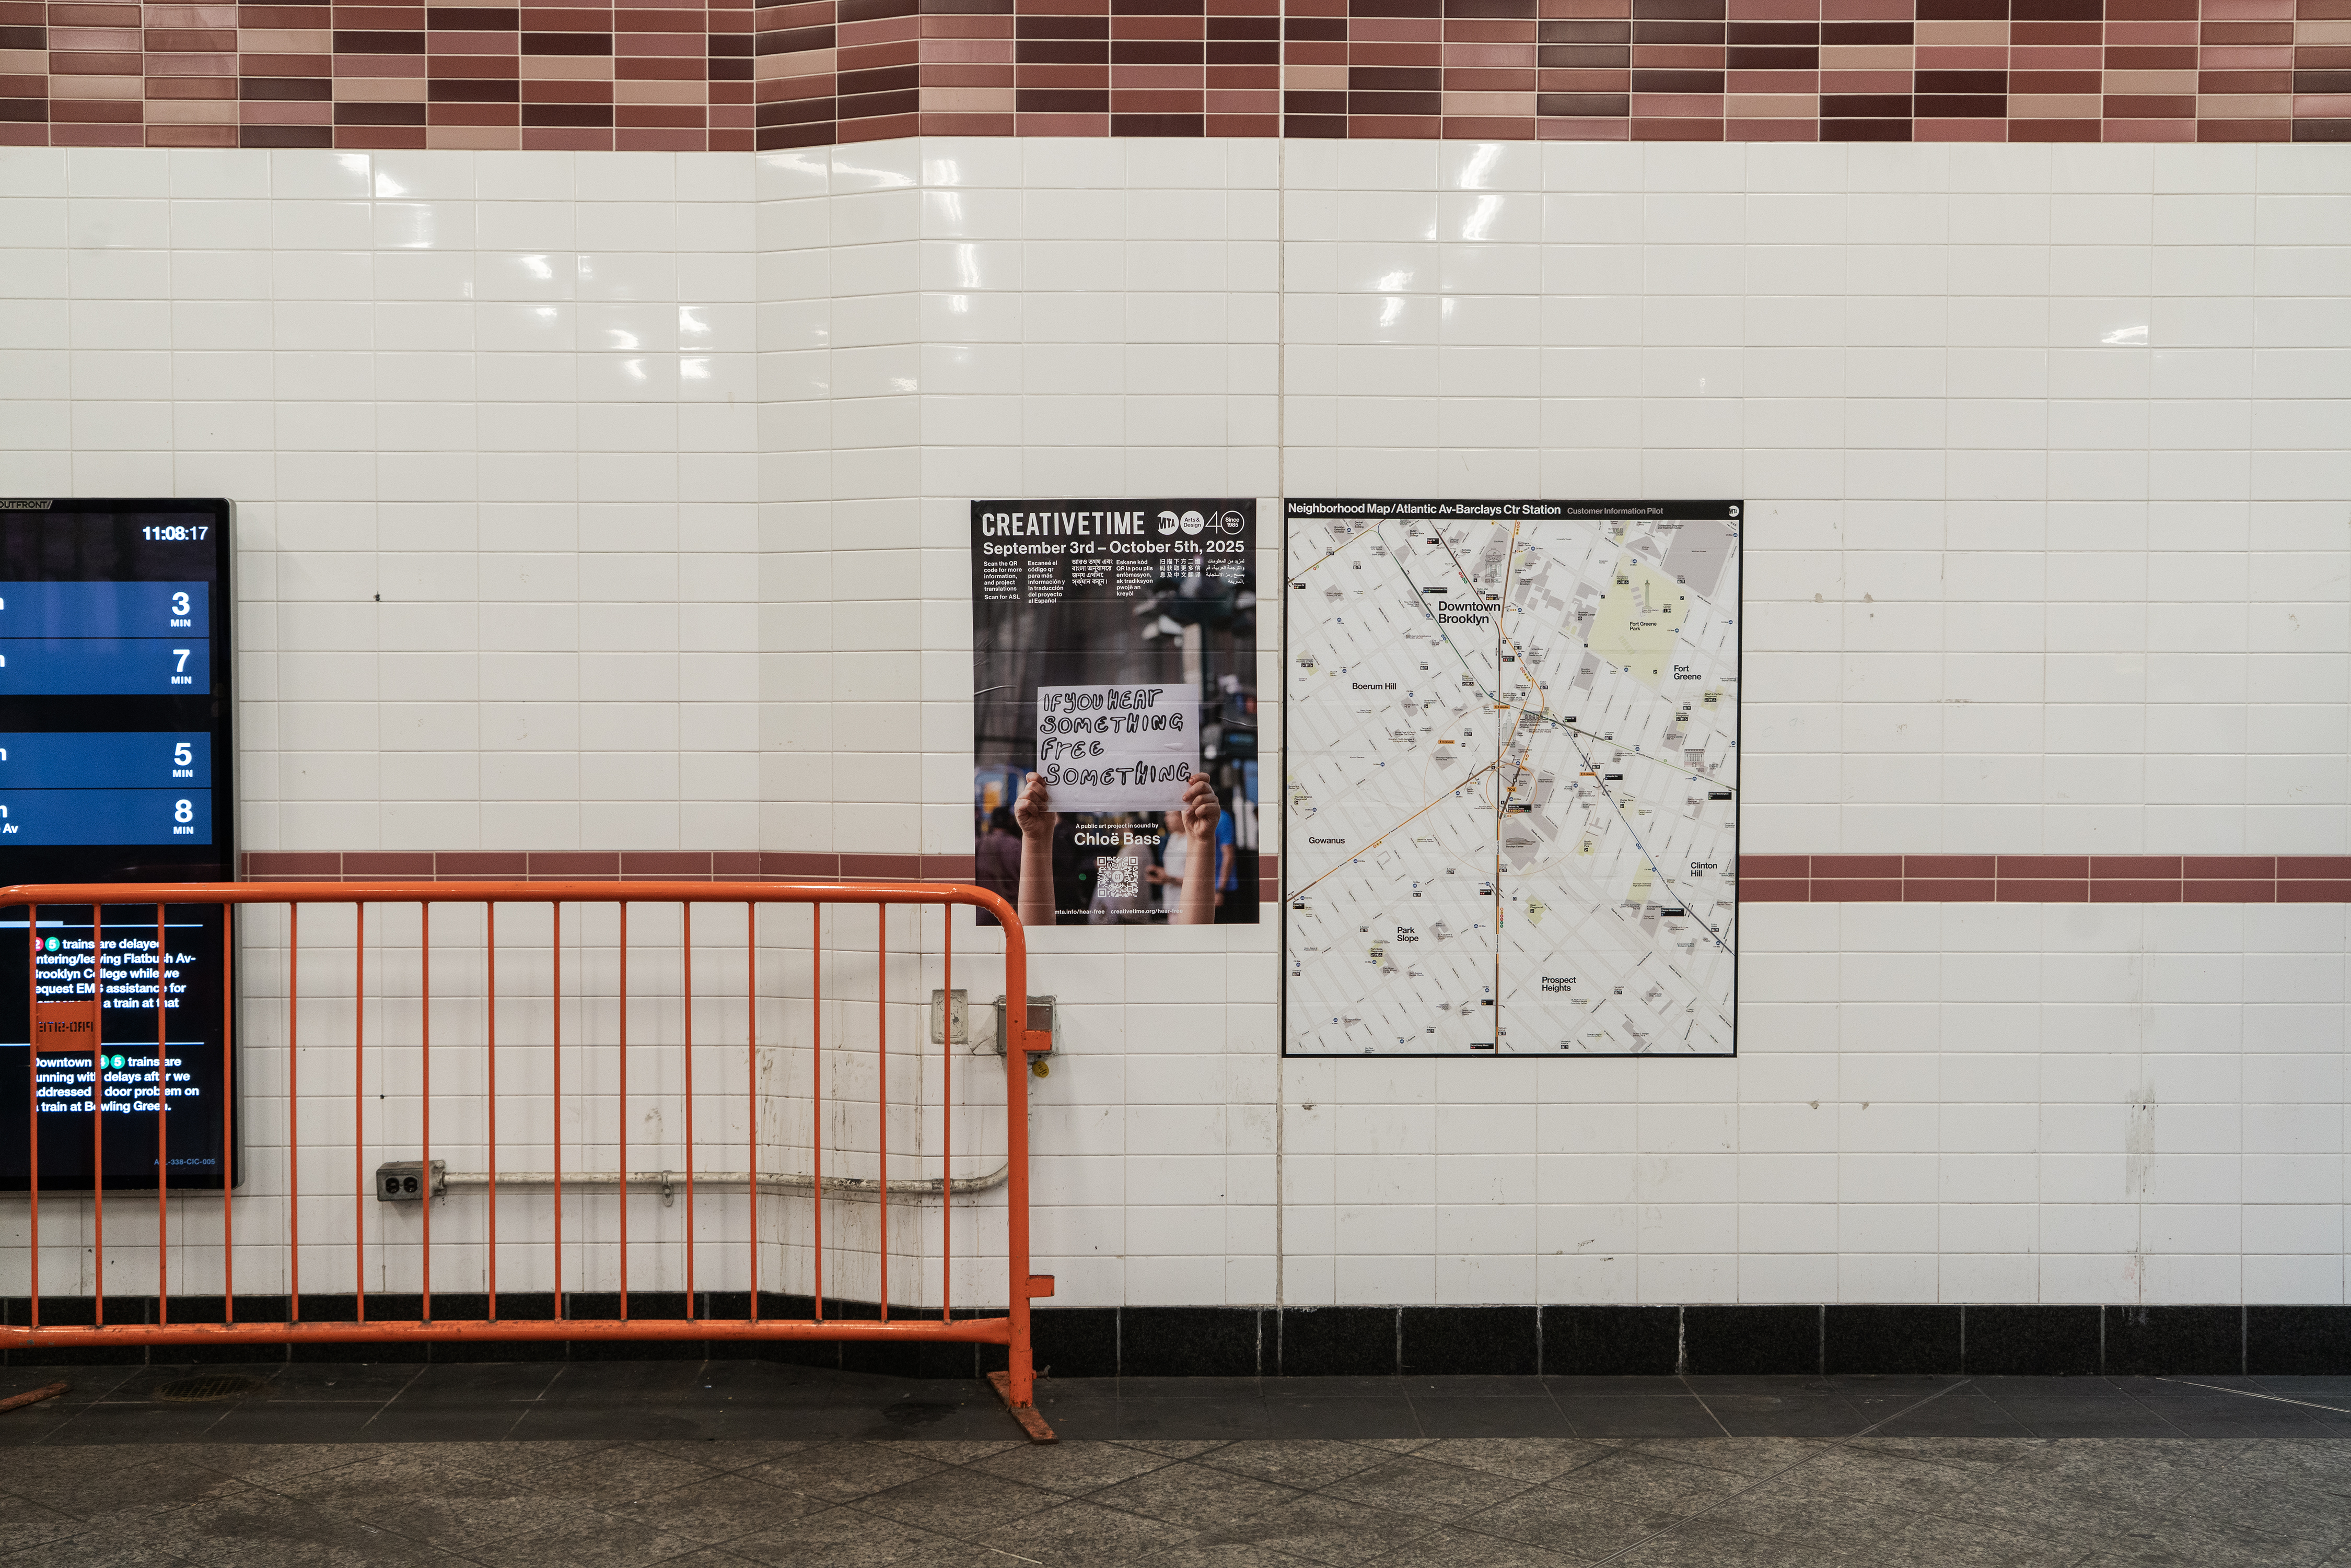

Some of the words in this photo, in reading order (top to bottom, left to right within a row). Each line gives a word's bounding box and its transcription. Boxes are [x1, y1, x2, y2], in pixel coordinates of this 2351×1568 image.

[1289, 504, 1365, 514] Neighborhood
[1439, 505, 1502, 516] Av-Barclays
[1504, 505, 1520, 514] Ctr
[1522, 505, 1561, 514] Station
[983, 512, 1144, 536] CREATIVETIME
[143, 526, 208, 540] 11:08:17
[984, 542, 1066, 556] September
[1070, 541, 1094, 553] 3rd
[1110, 541, 1170, 553] October
[1174, 541, 1202, 555] 5th,
[1206, 541, 1244, 552] 2025
[172, 592, 190, 615] 3
[1438, 601, 1501, 613] Downtown
[1438, 614, 1488, 626] Brooklyn
[173, 650, 190, 672] 7
[1043, 693, 1063, 712] IF
[1040, 712, 1184, 734] SOMETHING
[174, 743, 192, 766] 5
[1043, 760, 1192, 786] SOMETHING
[175, 800, 192, 823] 8
[3, 823, 18, 833] Av
[1075, 833, 1119, 845] Chloë
[1124, 833, 1160, 846] Bass
[49, 940, 56, 949] 5
[62, 939, 95, 949] trains
[36, 953, 121, 966] ntering/leaing
[176, 953, 196, 963] Av-
[130, 968, 159, 978] while
[164, 970, 180, 978] we
[1542, 977, 1576, 985] Prospect
[36, 984, 74, 996] equest
[169, 982, 187, 993] for
[1542, 984, 1570, 992] Heights
[103, 999, 111, 1008] a
[113, 998, 139, 1008] train
[142, 998, 154, 1008] at
[114, 1057, 121, 1067] 5
[127, 1056, 160, 1067] trains
[164, 1058, 182, 1067] are
[36, 1072, 74, 1084] unning
[103, 1071, 142, 1084] delays
[144, 1071, 171, 1081] aftr
[173, 1073, 191, 1081] we
[36, 1086, 92, 1097] ddressed
[104, 1086, 132, 1096] door
[134, 1086, 182, 1098] probem
[184, 1087, 200, 1096] on
[41, 1101, 67, 1111] train
[70, 1102, 82, 1111] at
